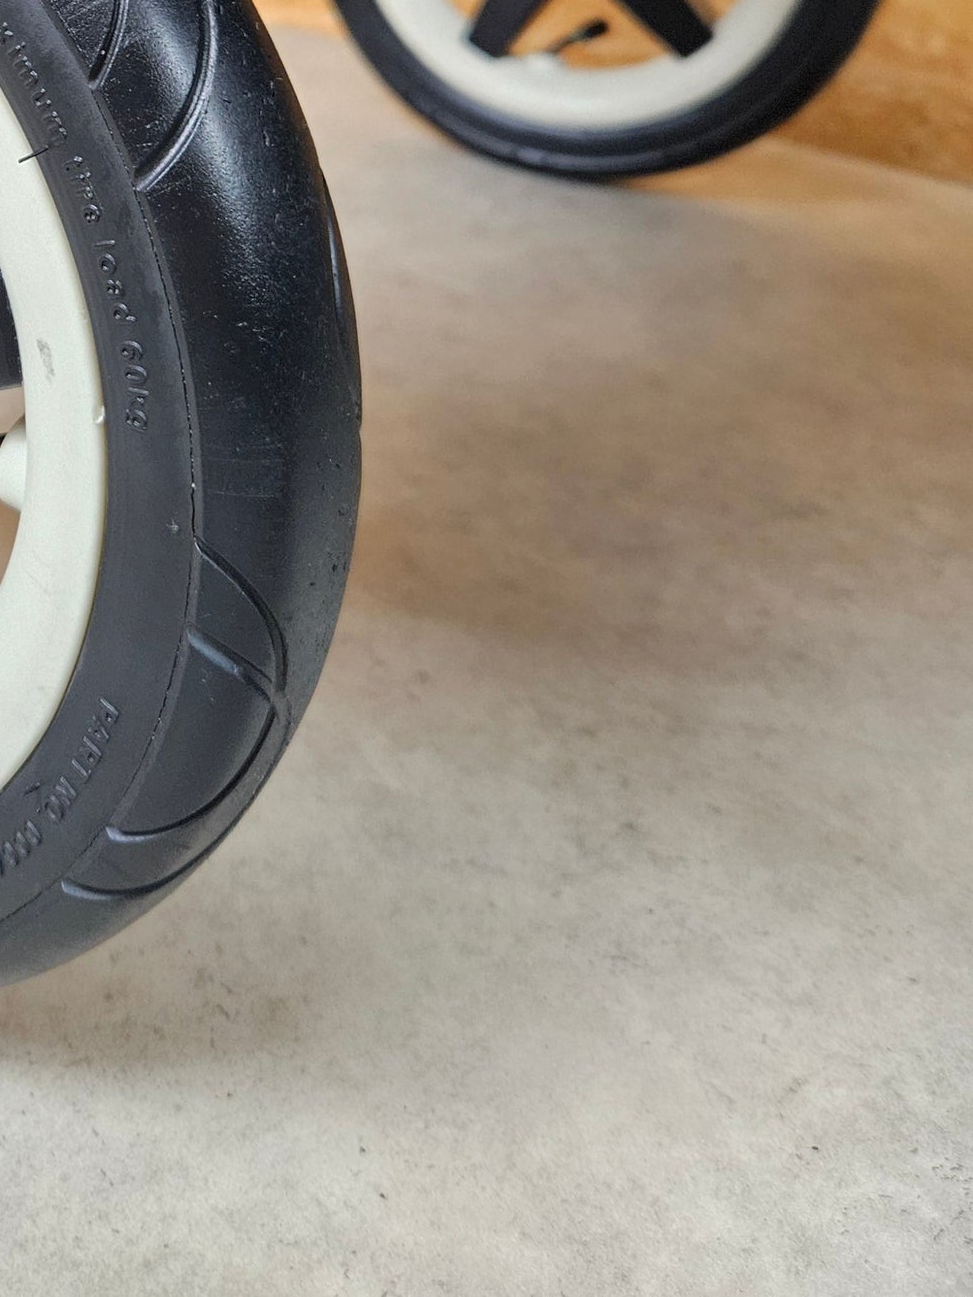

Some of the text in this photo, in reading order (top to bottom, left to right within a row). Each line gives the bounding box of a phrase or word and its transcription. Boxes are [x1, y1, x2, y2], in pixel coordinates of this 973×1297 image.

[93, 238, 138, 323] load
[120, 339, 150, 432] 60kg
[71, 697, 121, 785] PART
